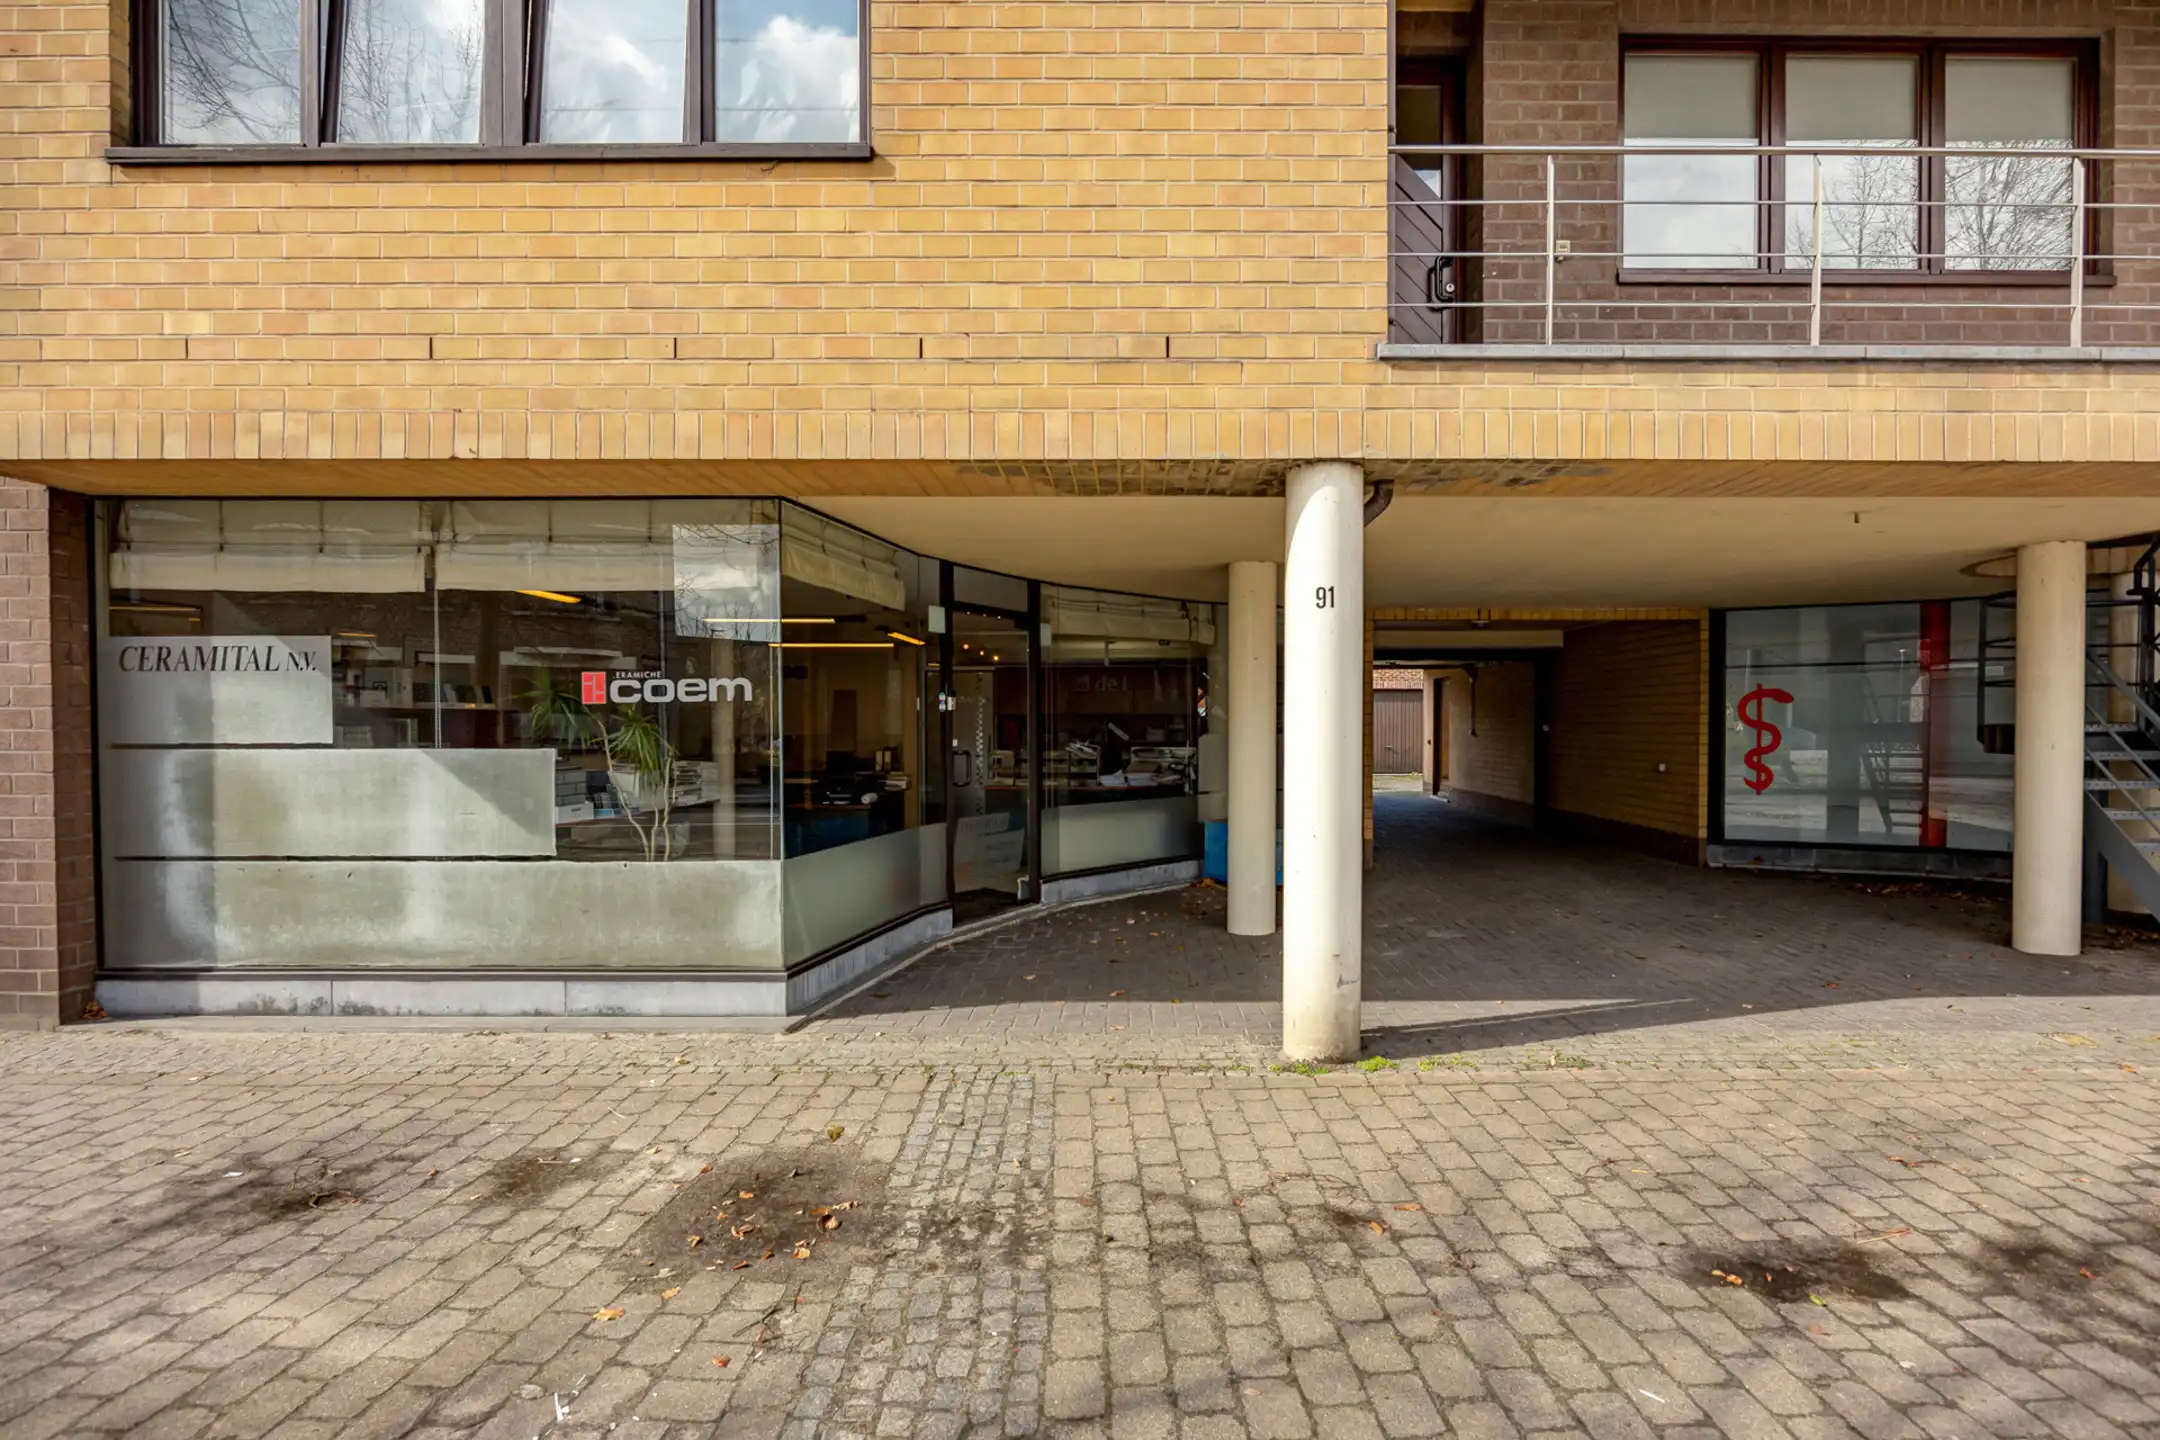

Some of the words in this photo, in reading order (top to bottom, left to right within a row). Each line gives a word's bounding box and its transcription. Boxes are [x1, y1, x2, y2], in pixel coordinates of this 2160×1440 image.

[1316, 586, 1334, 609] 91
[119, 645, 280, 672] CERAMITAL
[286, 651, 317, 671] N.V.
[613, 671, 662, 679] ERAMICHE
[609, 677, 753, 703] coem
